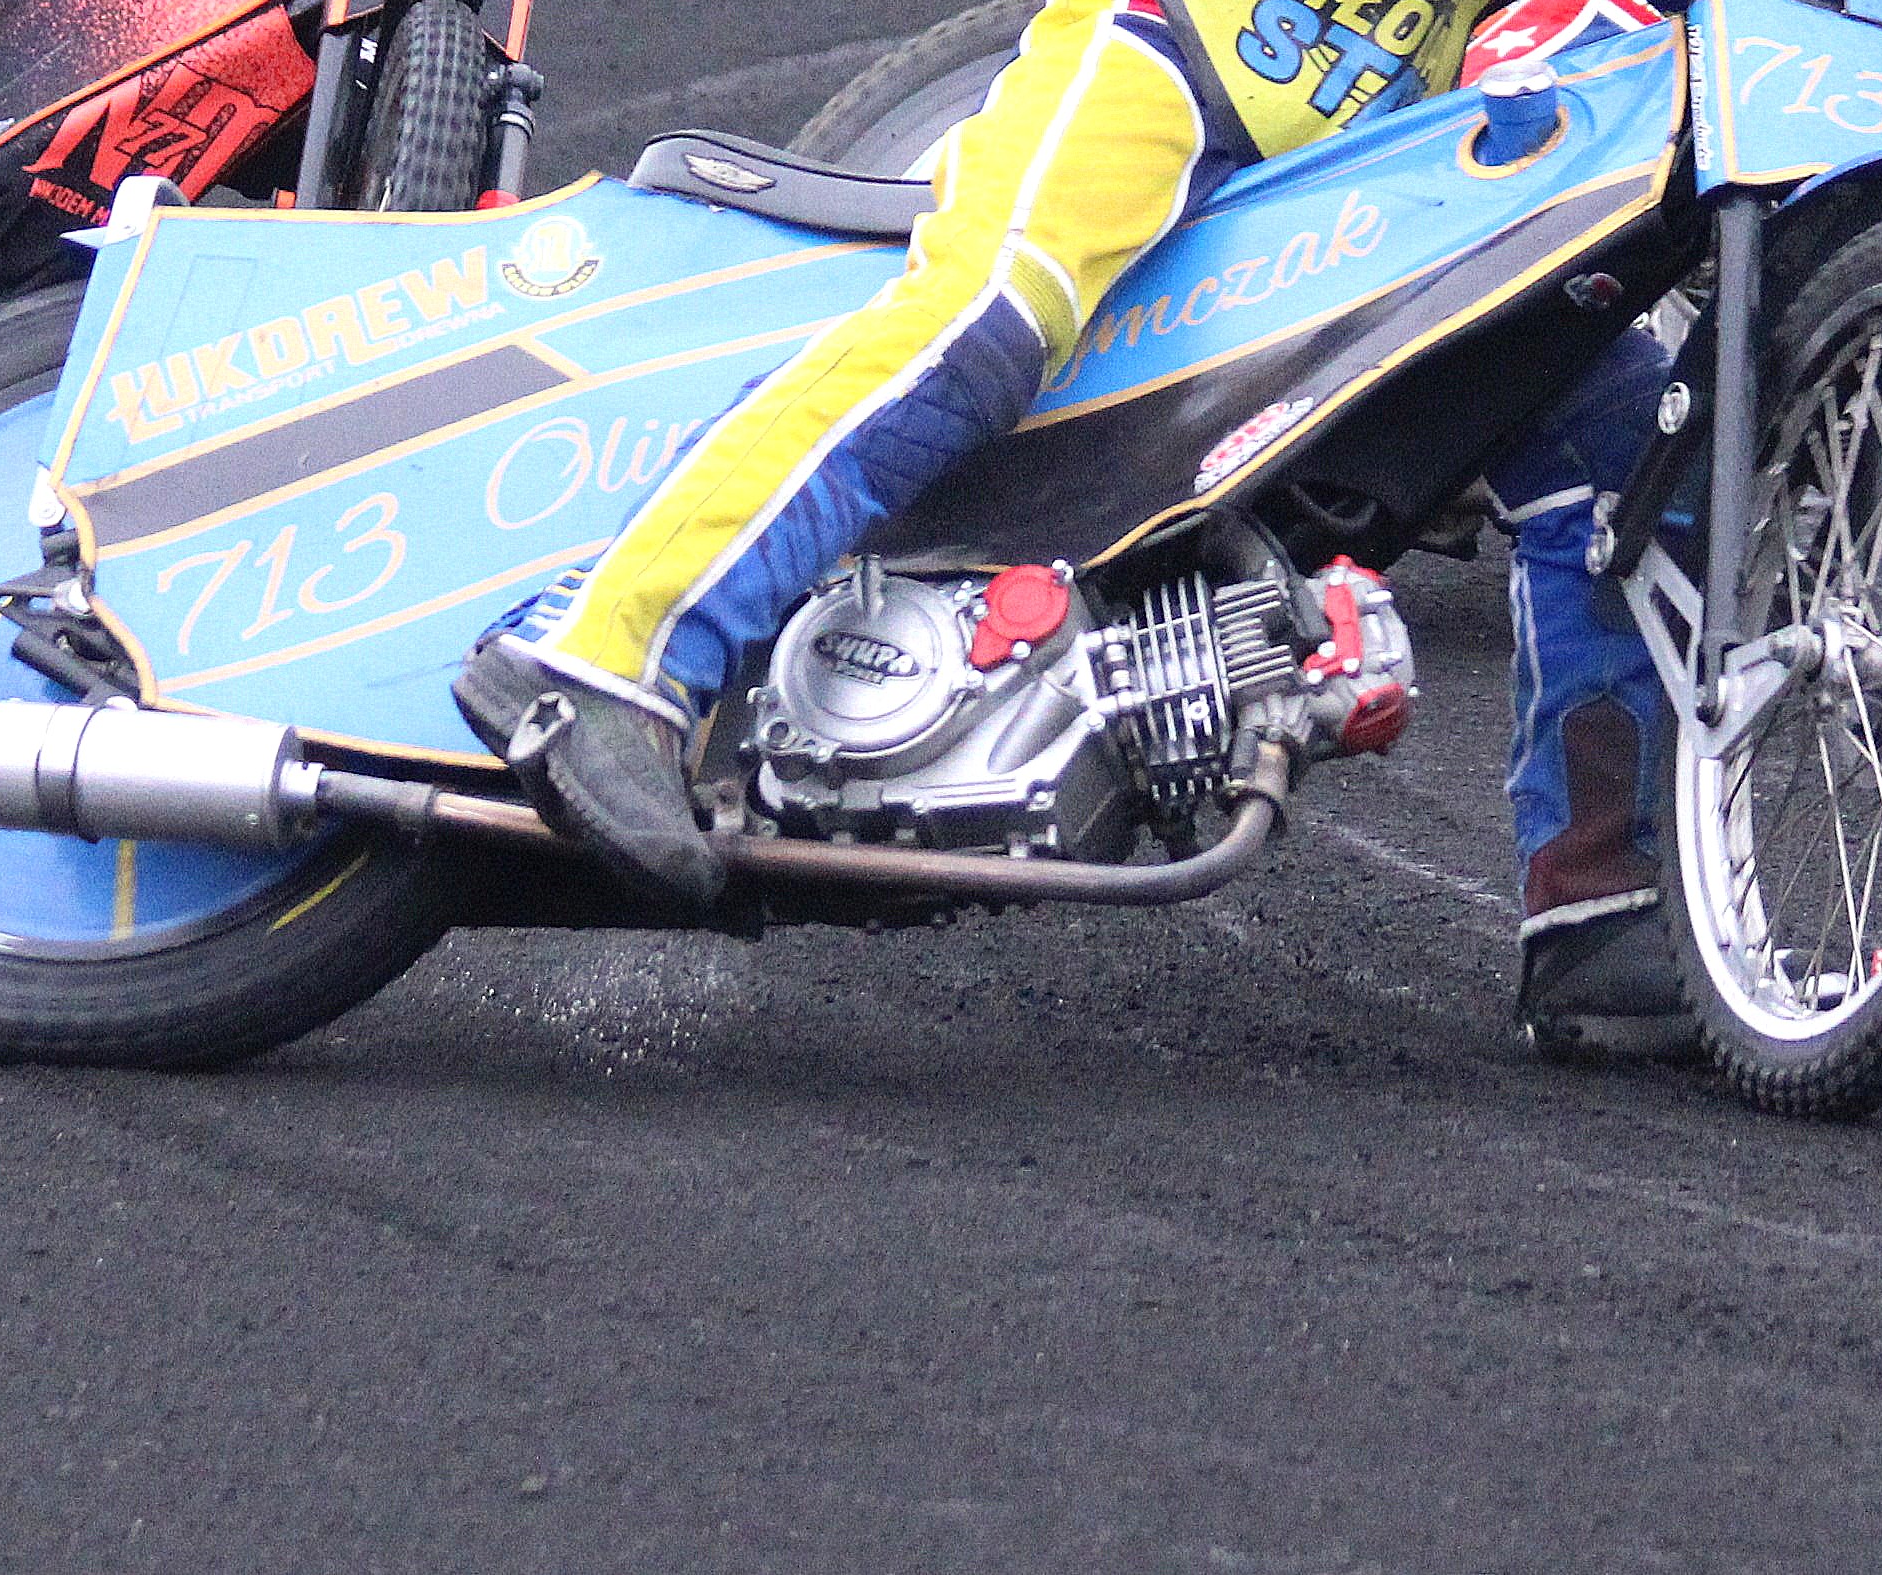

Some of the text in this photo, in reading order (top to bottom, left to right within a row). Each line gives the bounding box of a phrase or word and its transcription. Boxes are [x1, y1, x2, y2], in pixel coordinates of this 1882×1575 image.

[104, 246, 491, 444] ŁUKDREW
[179, 362, 338, 426] TRANSPORT
[155, 490, 407, 655] 713
